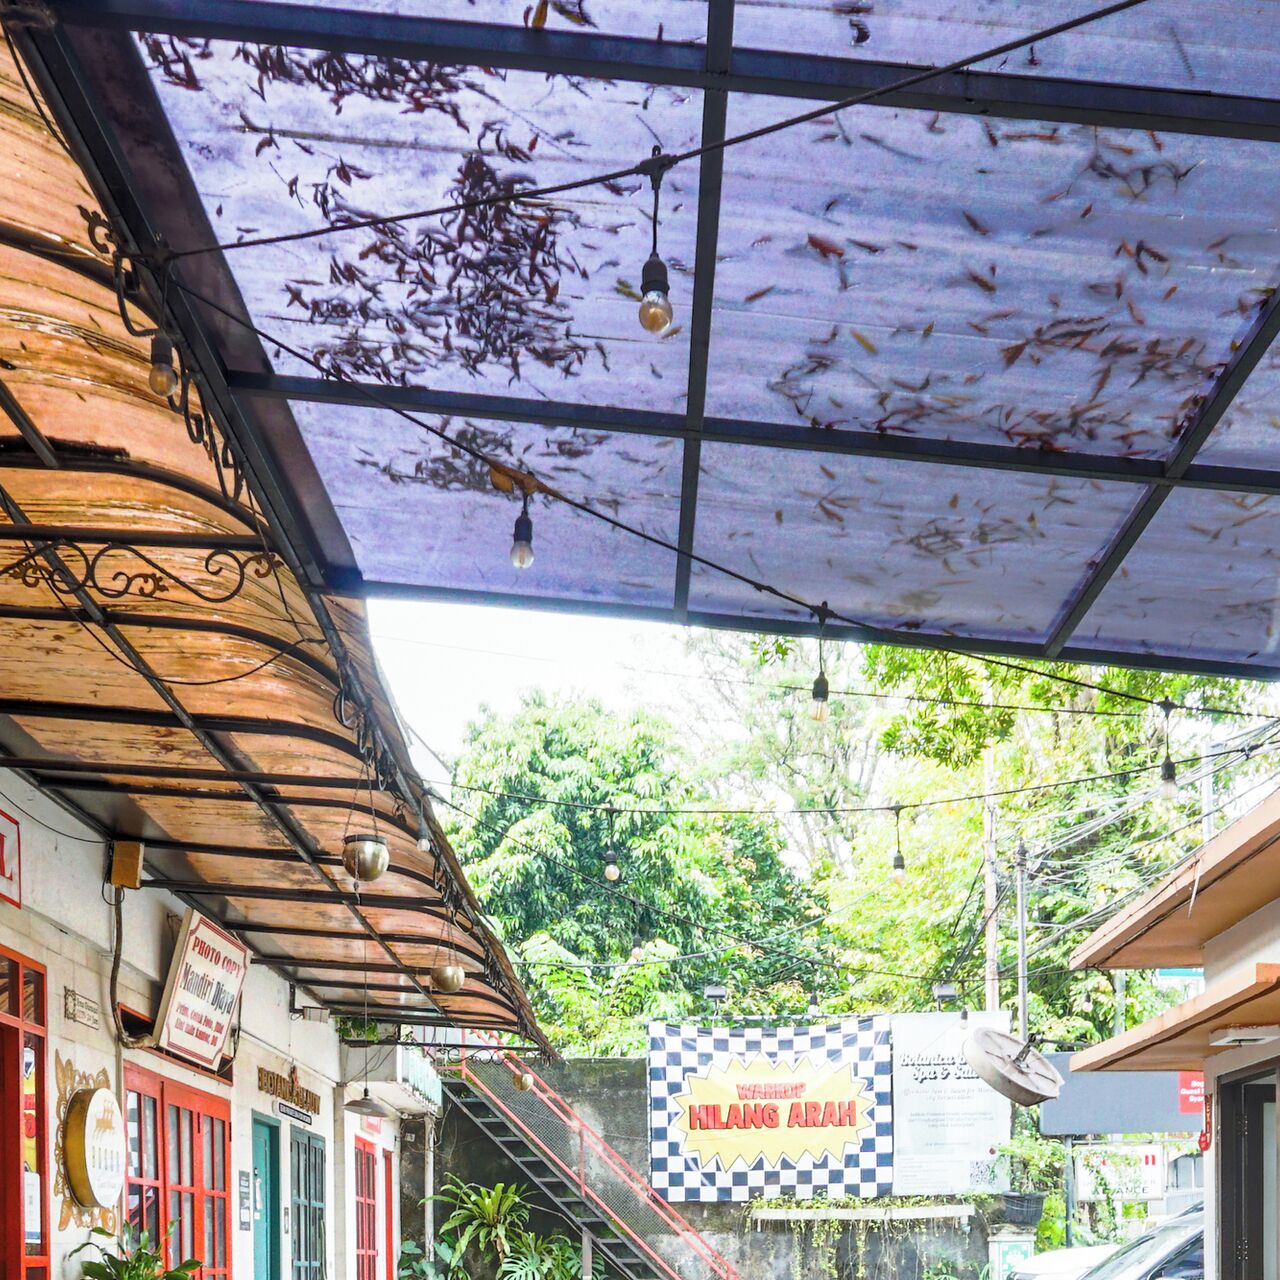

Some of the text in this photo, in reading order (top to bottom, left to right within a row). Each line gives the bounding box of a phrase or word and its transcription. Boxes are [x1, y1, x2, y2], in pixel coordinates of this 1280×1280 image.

[192, 936, 243, 978] PHOTO COPY
[180, 962, 236, 1016] Mandiri Djaya
[911, 1066, 938, 1084] Spa
[940, 1067, 951, 1080] &
[735, 1083, 807, 1101] WARKOP
[688, 1100, 857, 1131] HILANG ARAH
